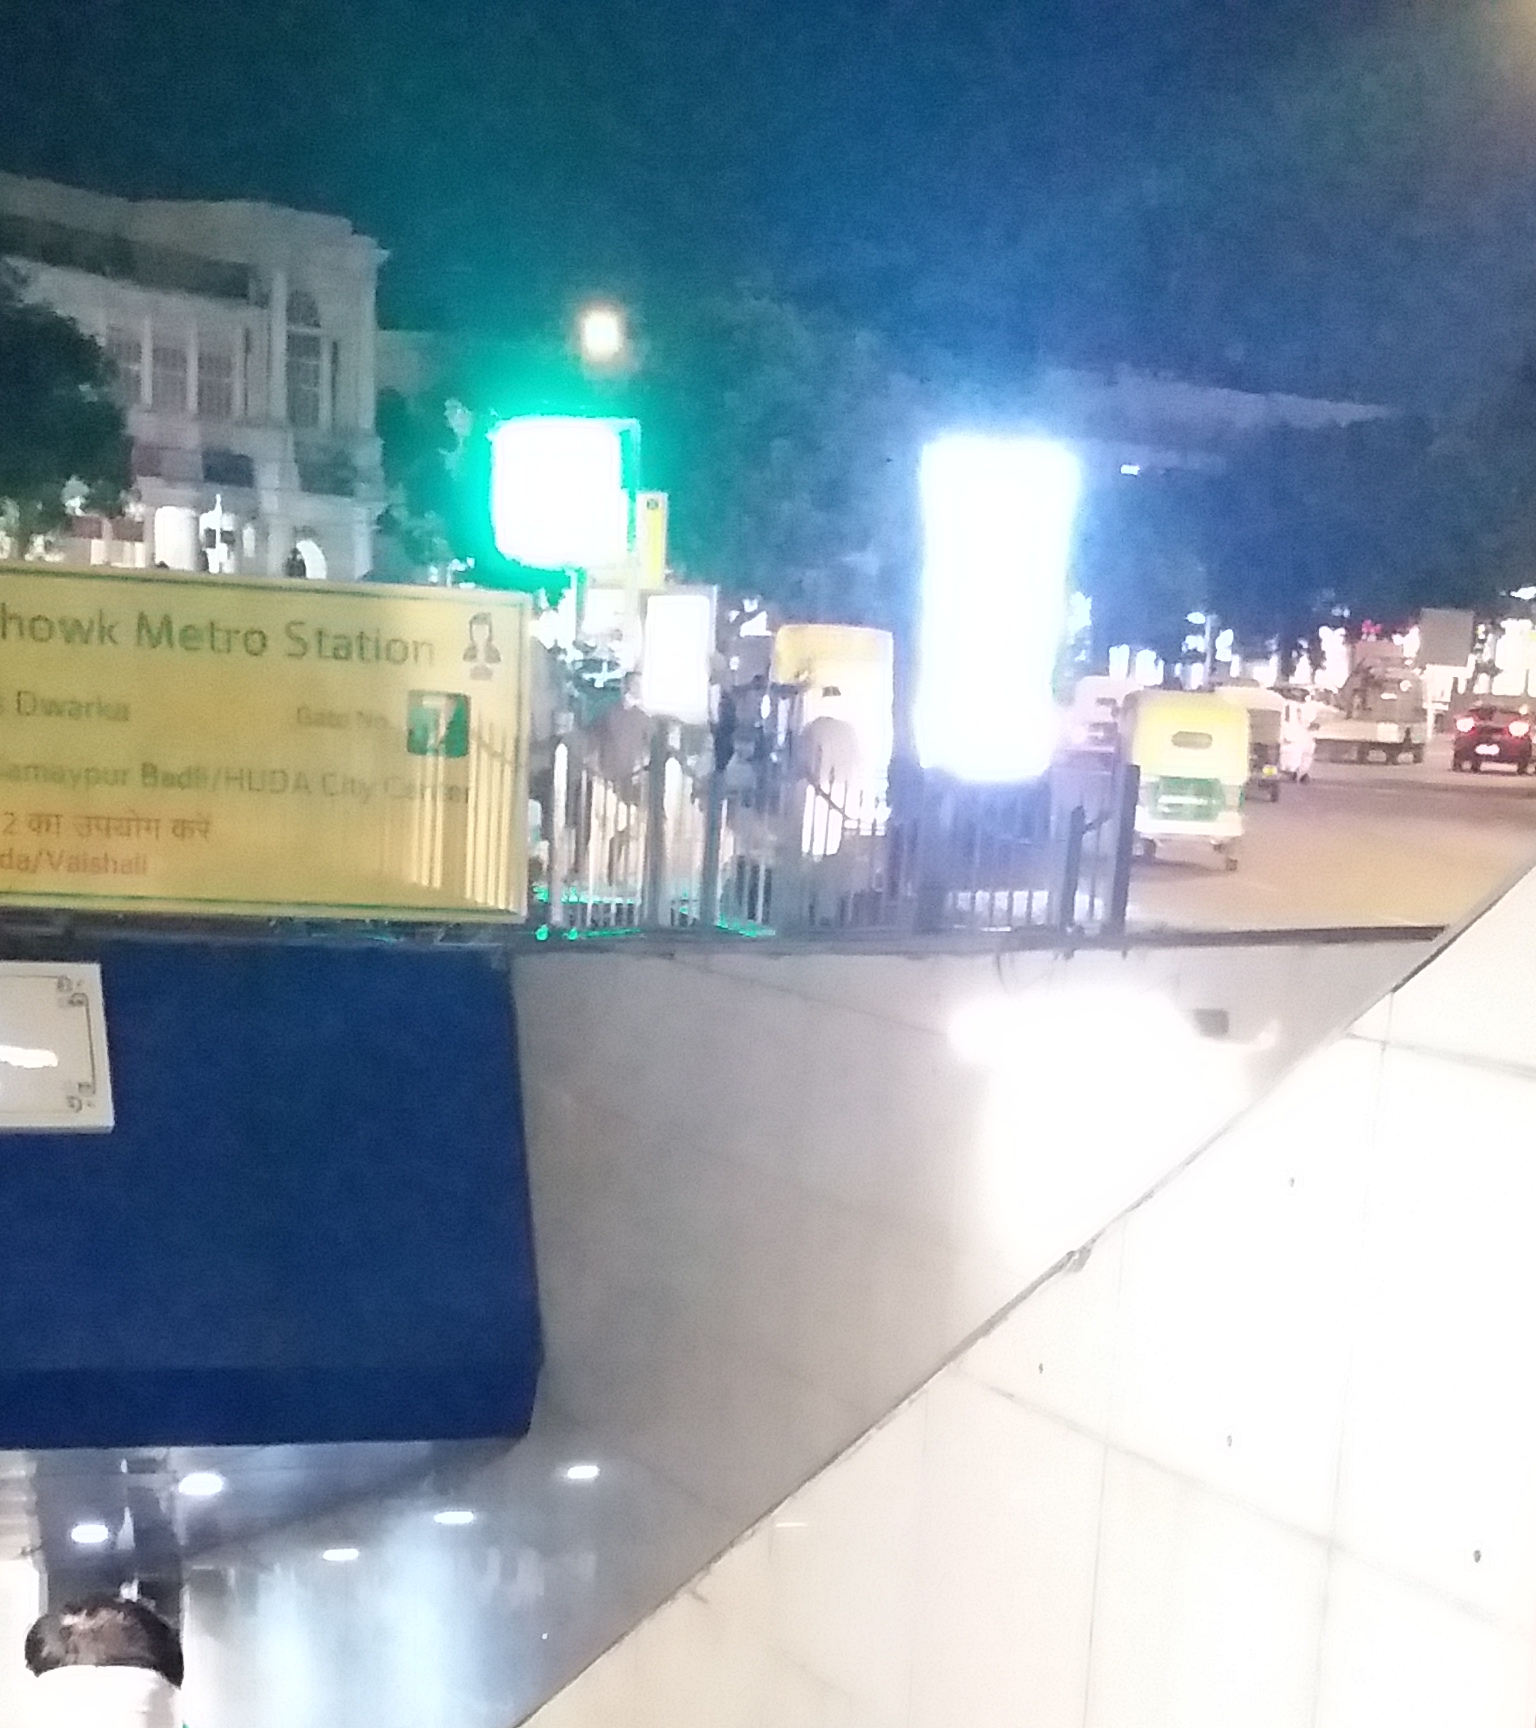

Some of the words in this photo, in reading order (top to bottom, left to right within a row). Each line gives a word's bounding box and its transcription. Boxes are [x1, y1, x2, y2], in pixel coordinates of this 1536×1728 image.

[136, 610, 268, 657] Metro
[284, 619, 435, 666] Station
[16, 689, 130, 722] Dwarka
[1, 810, 16, 836] 2
